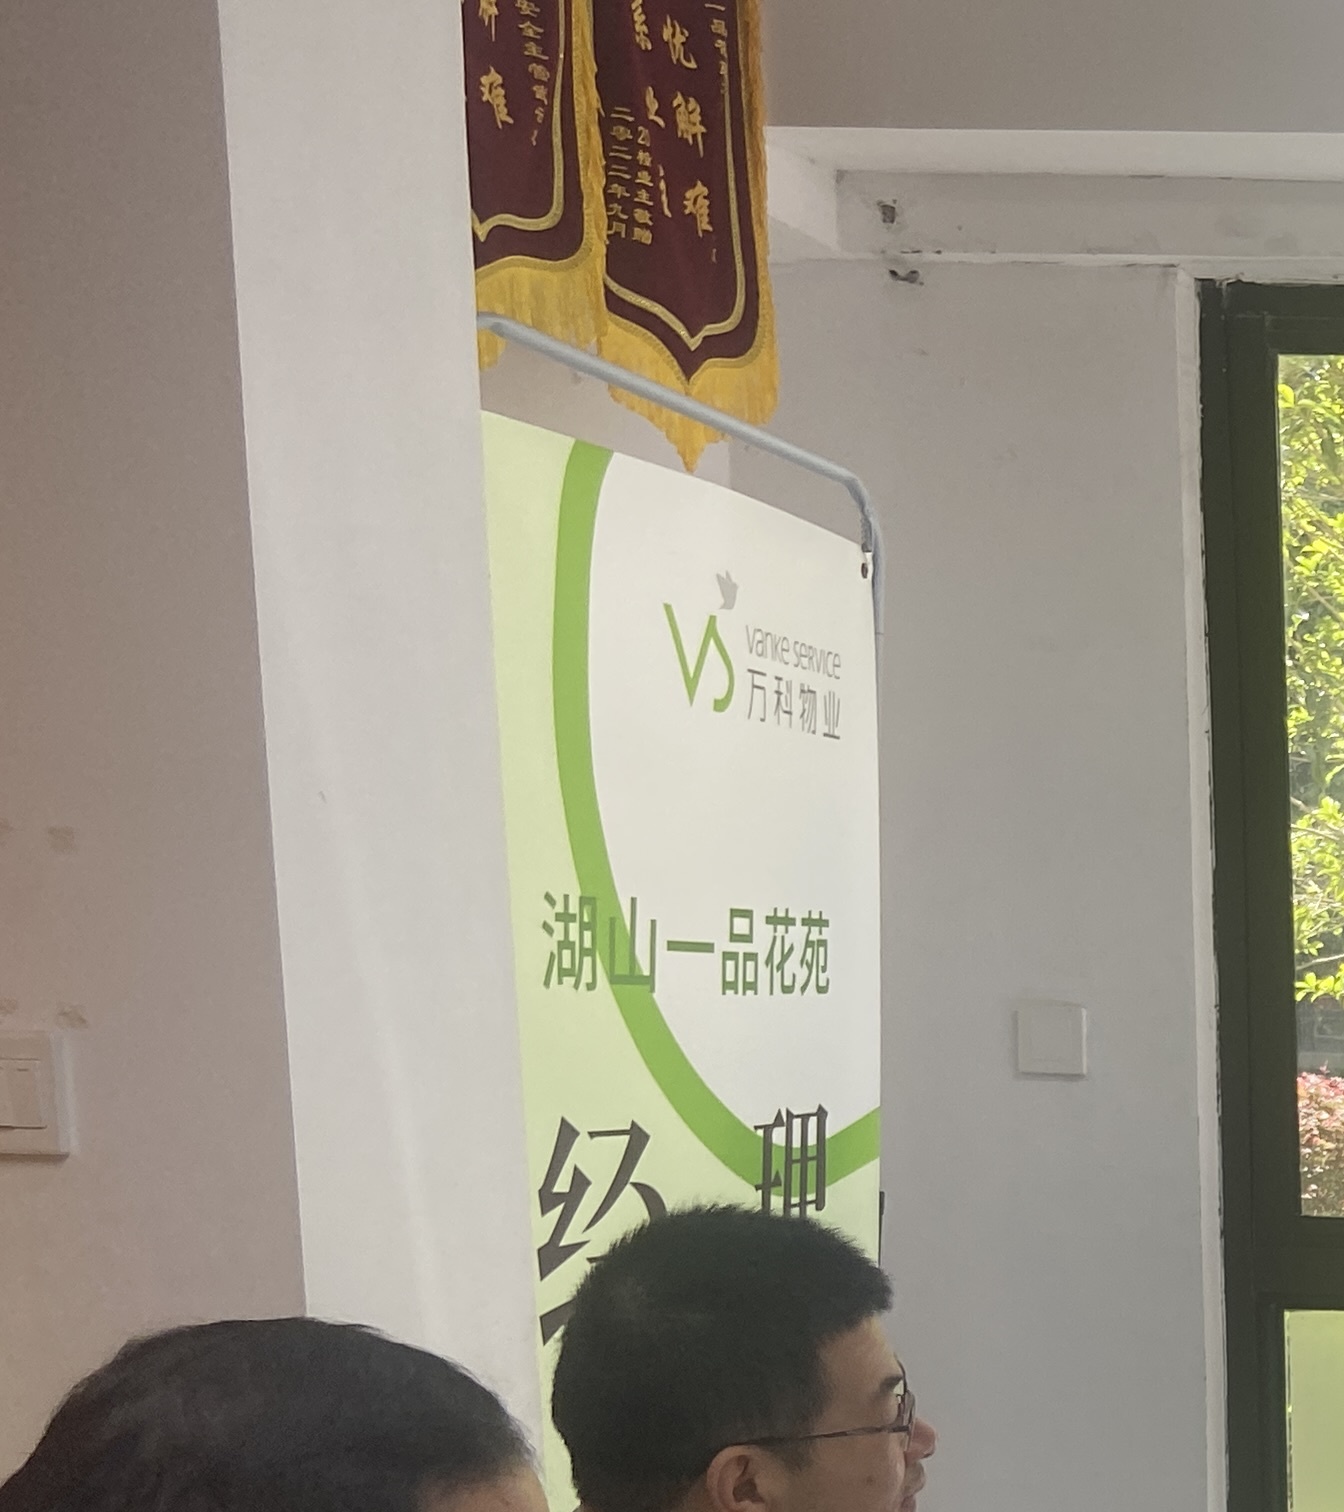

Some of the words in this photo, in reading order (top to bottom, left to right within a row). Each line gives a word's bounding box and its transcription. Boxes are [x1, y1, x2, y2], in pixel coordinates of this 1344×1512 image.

[606, 106, 635, 238] 二零二二年九月
[747, 668, 840, 740] 万科物业
[542, 891, 830, 996] 湖山一品花苑
